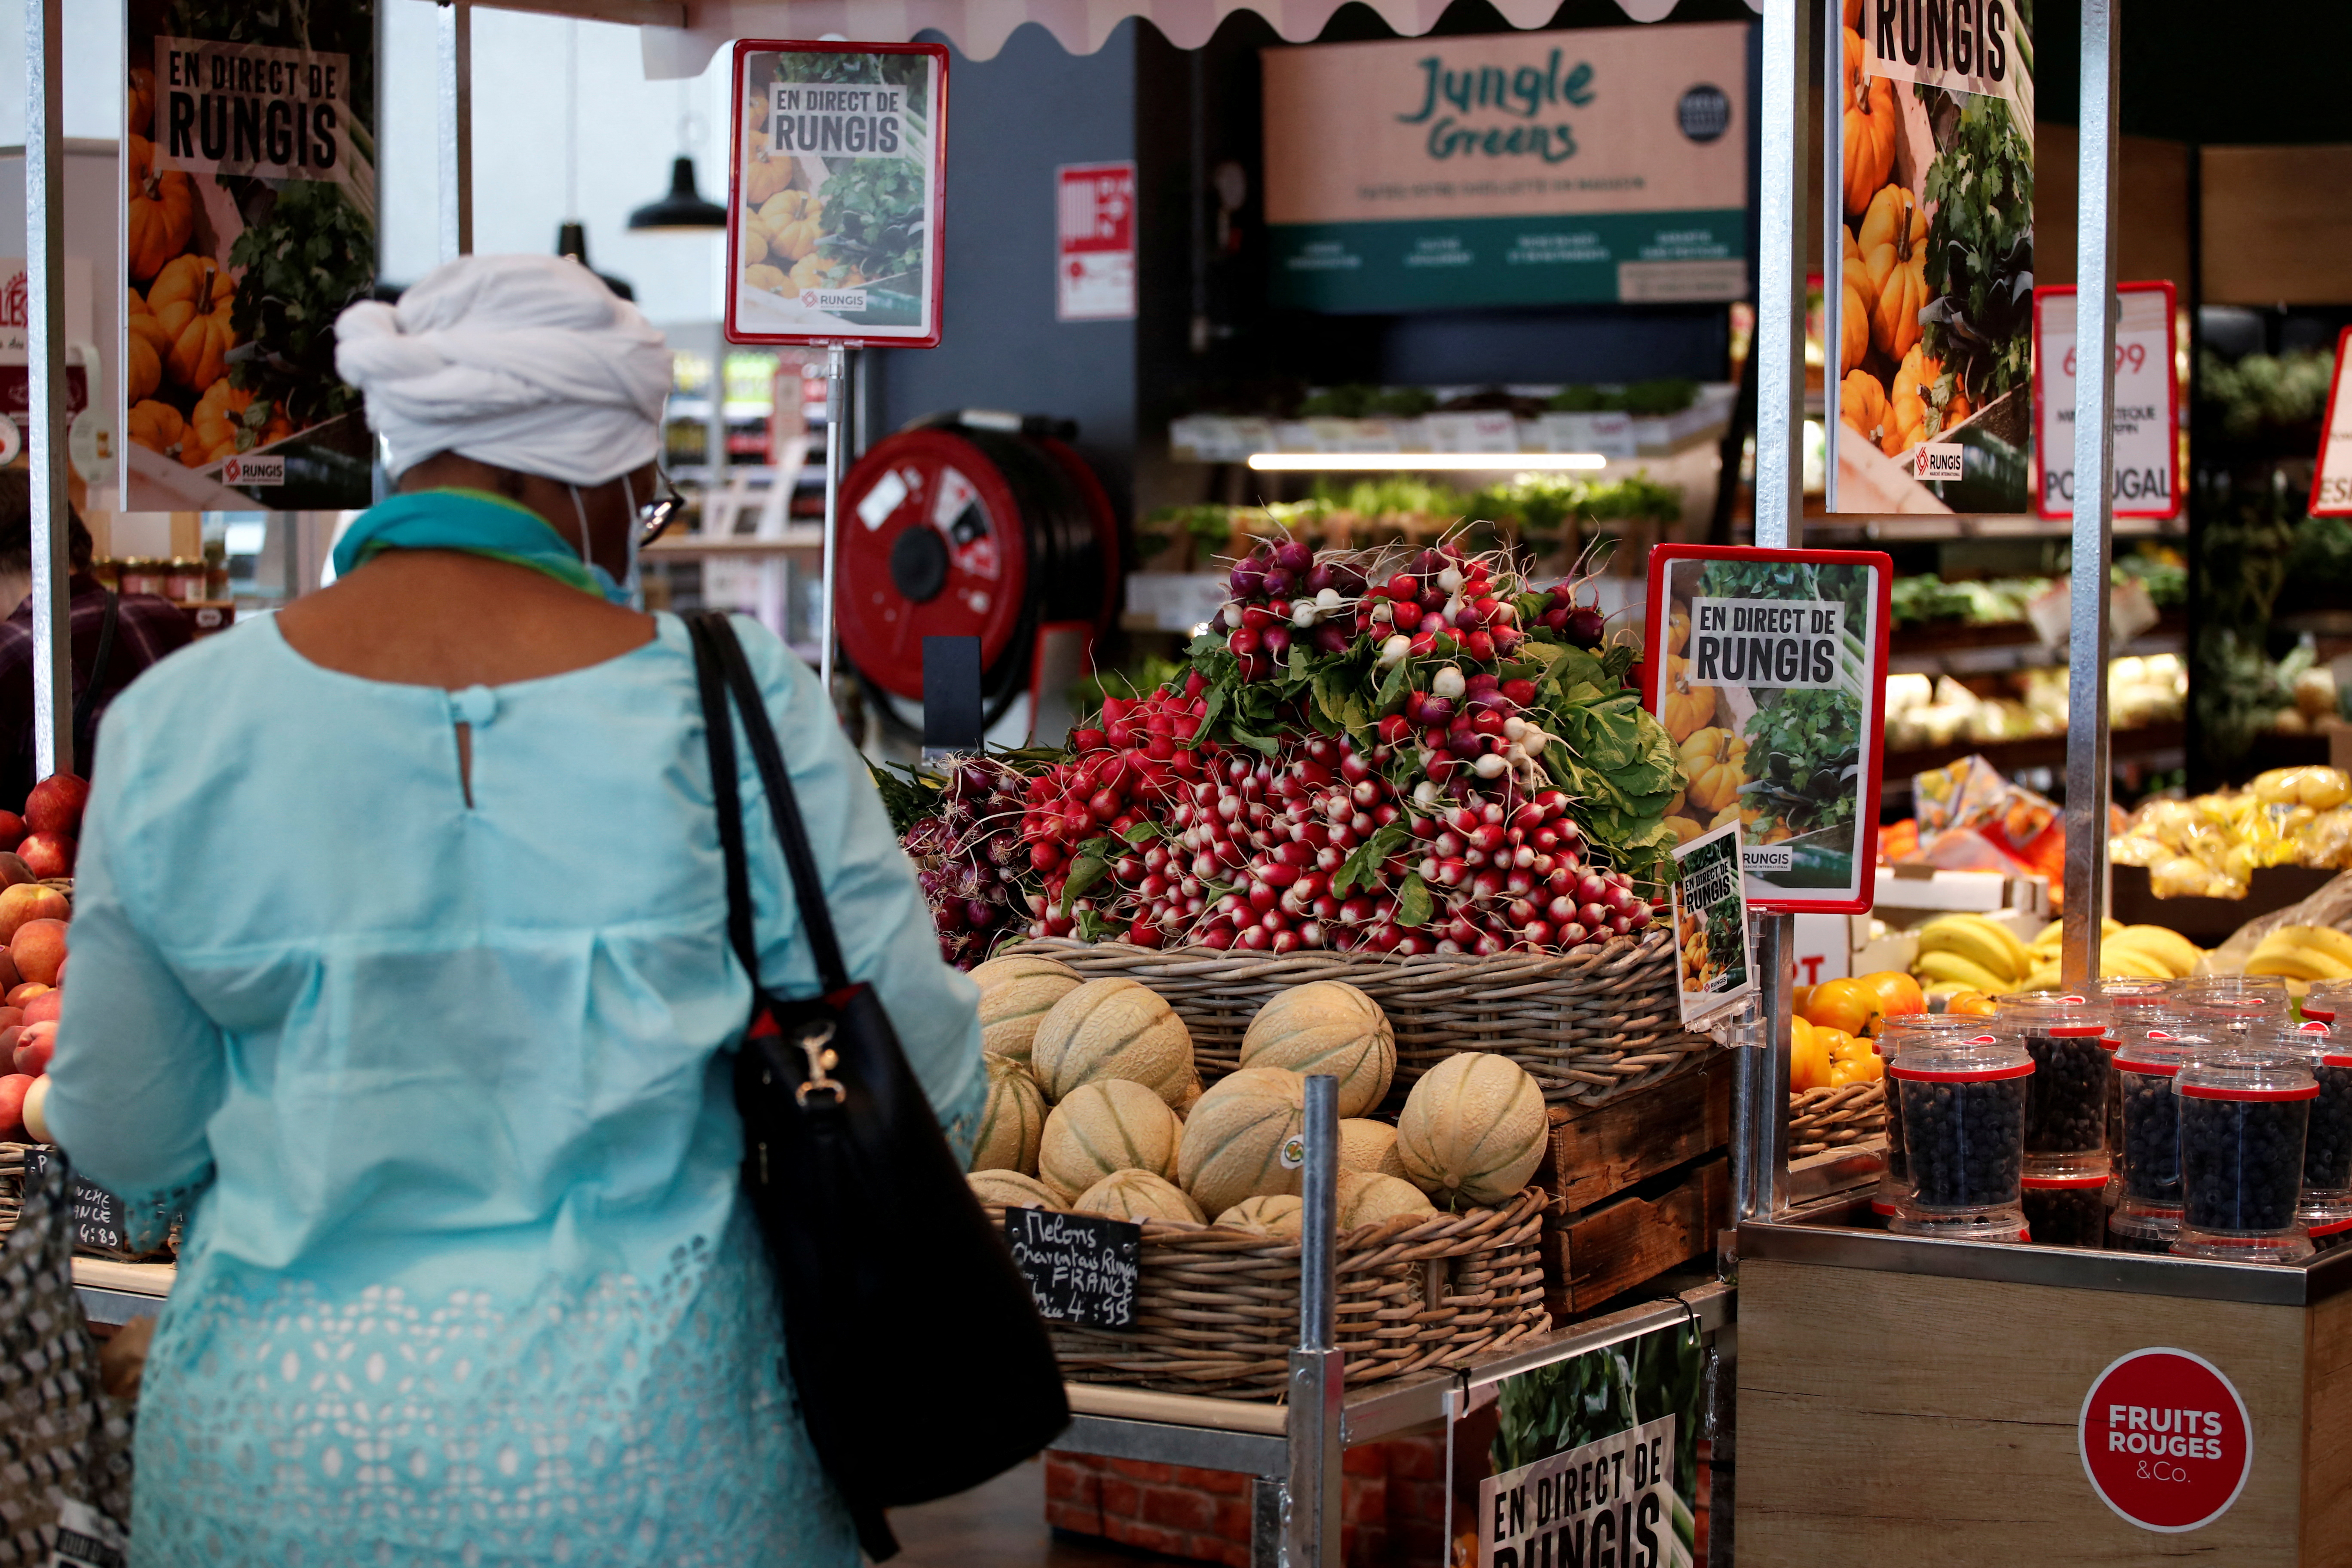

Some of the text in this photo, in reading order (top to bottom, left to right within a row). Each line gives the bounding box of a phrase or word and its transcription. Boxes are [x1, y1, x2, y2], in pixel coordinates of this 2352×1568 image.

[1877, 0, 2006, 82] RUNGIS
[170, 51, 336, 99] EN DIRECT DE
[1395, 47, 1597, 123] Jungle
[777, 90, 899, 112] EN DIRECT DE
[170, 91, 337, 169] RUNGIS
[775, 115, 899, 153] RUNGIS
[1427, 117, 1577, 163] Greens
[821, 295, 863, 305] RUNGIS
[243, 464, 283, 478] RUNGIS
[1930, 454, 1960, 470] RUNGIS
[2046, 467, 2171, 499] POUGAL
[1700, 606, 1836, 635] EN DIRECT DE
[1697, 636, 1834, 683] RUNGIS
[1743, 853, 1789, 864] RUNGIS
[1685, 861, 1728, 892] EN DIRECT DE
[1686, 875, 1730, 914] RUNGIS
[1711, 977, 1726, 989] RUNGIS
[1026, 1211, 1096, 1248] Melons
[1052, 1266, 1132, 1298] FRANCE
[2109, 1404, 2222, 1436] FRUITS
[2109, 1431, 2222, 1460] ROUGES
[2137, 1460, 2191, 1482] &Co.
[1494, 1436, 1662, 1543] EN DIRECT DE
